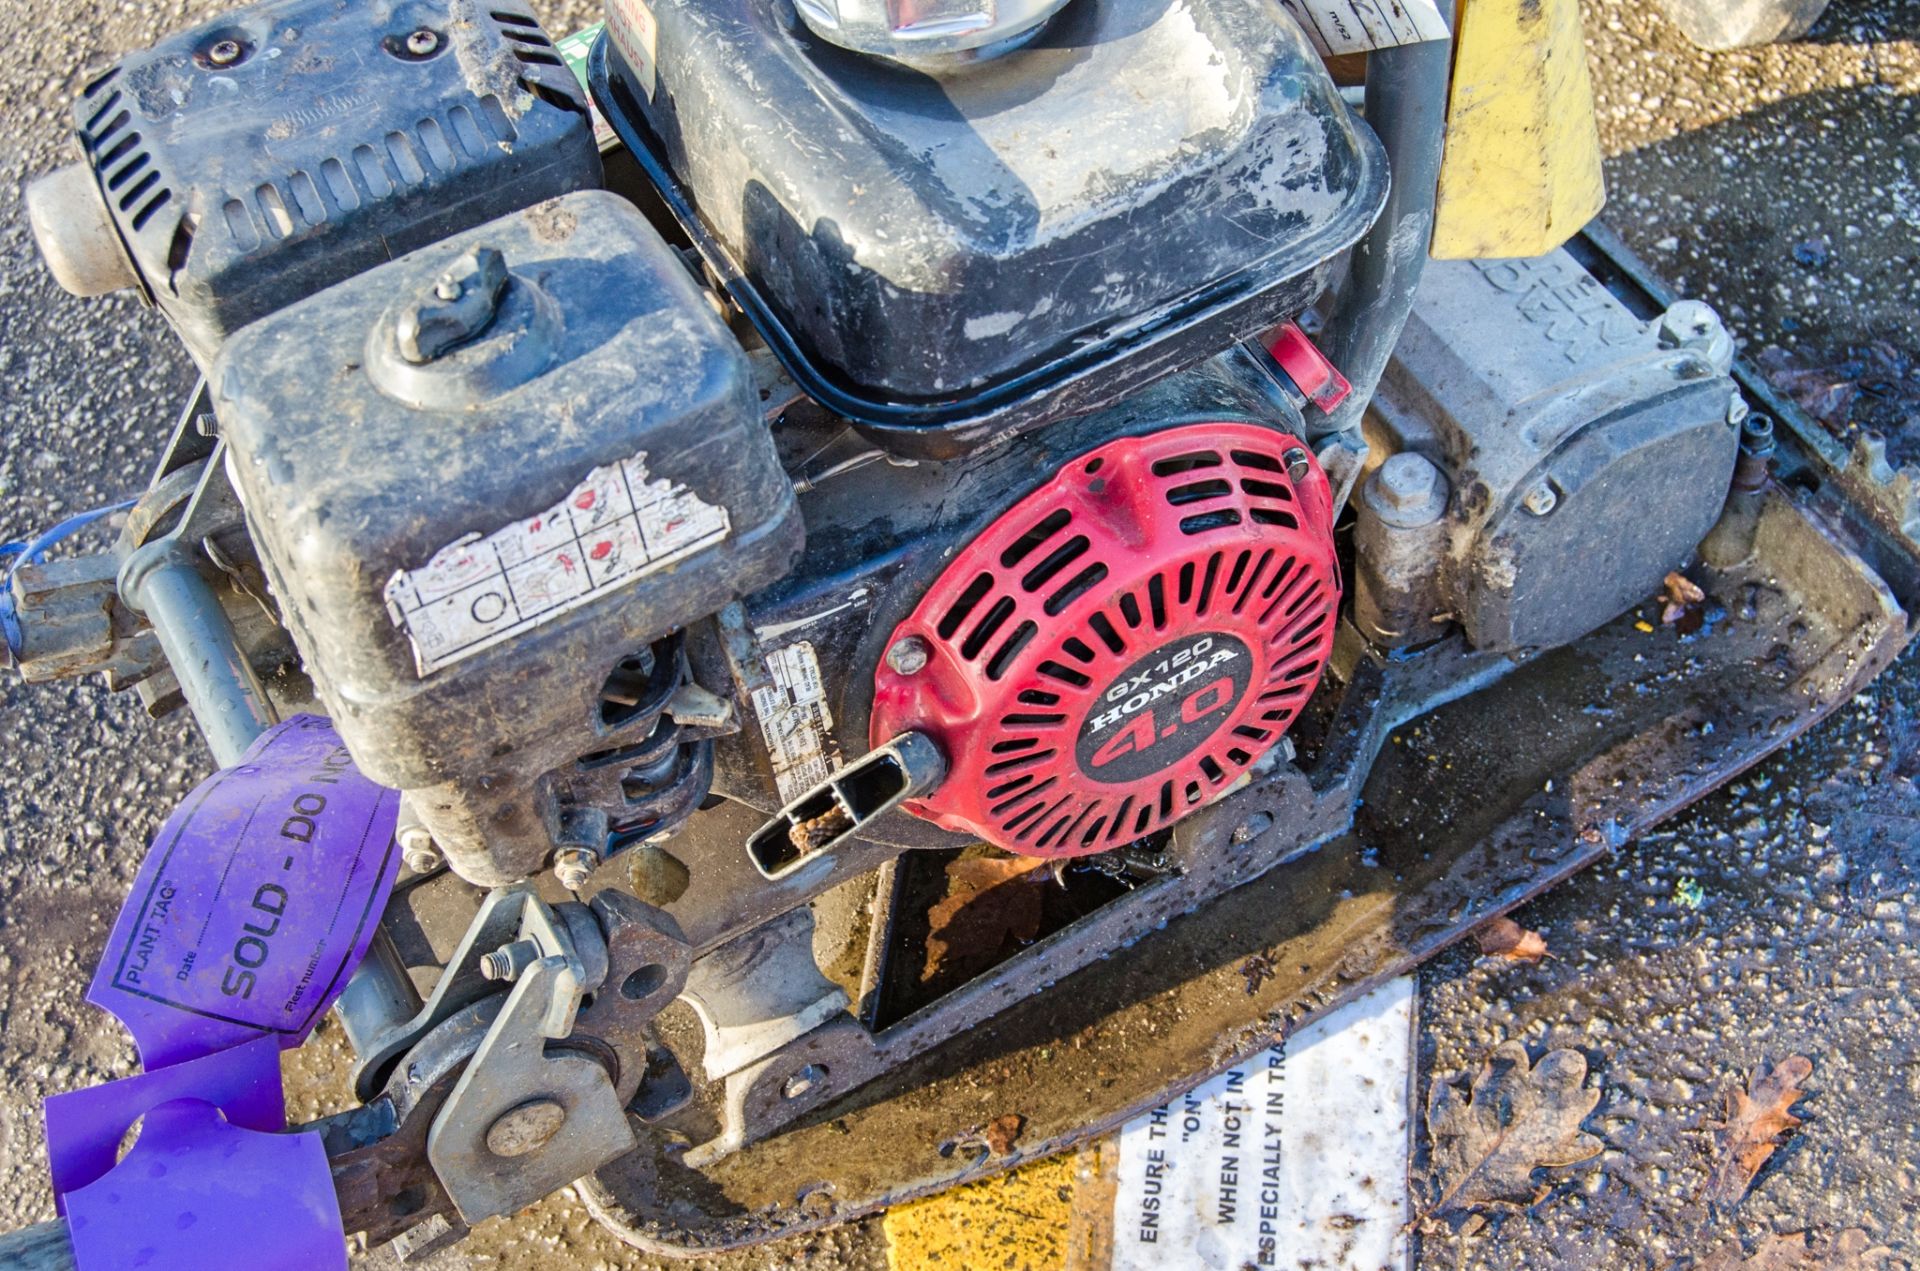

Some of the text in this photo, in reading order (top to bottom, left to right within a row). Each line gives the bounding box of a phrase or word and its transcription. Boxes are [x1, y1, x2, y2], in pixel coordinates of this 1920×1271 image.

[1089, 648, 1239, 733] HONDA
[1106, 637, 1213, 702] GX120
[1090, 676, 1234, 767] 4.0
[221, 883, 289, 1000] SOLD
[280, 793, 327, 843] DO
[310, 745, 352, 784] NO
[126, 923, 160, 984] PLANT
[176, 951, 197, 981] Date
[285, 938, 328, 1014] Fleet number
[1266, 1092, 1284, 1116] IN
[1218, 1070, 1244, 1224] WHEN NOT IN
[1140, 1149, 1165, 1244] ENSURE
[1257, 1123, 1283, 1266] ESPECIALLY
